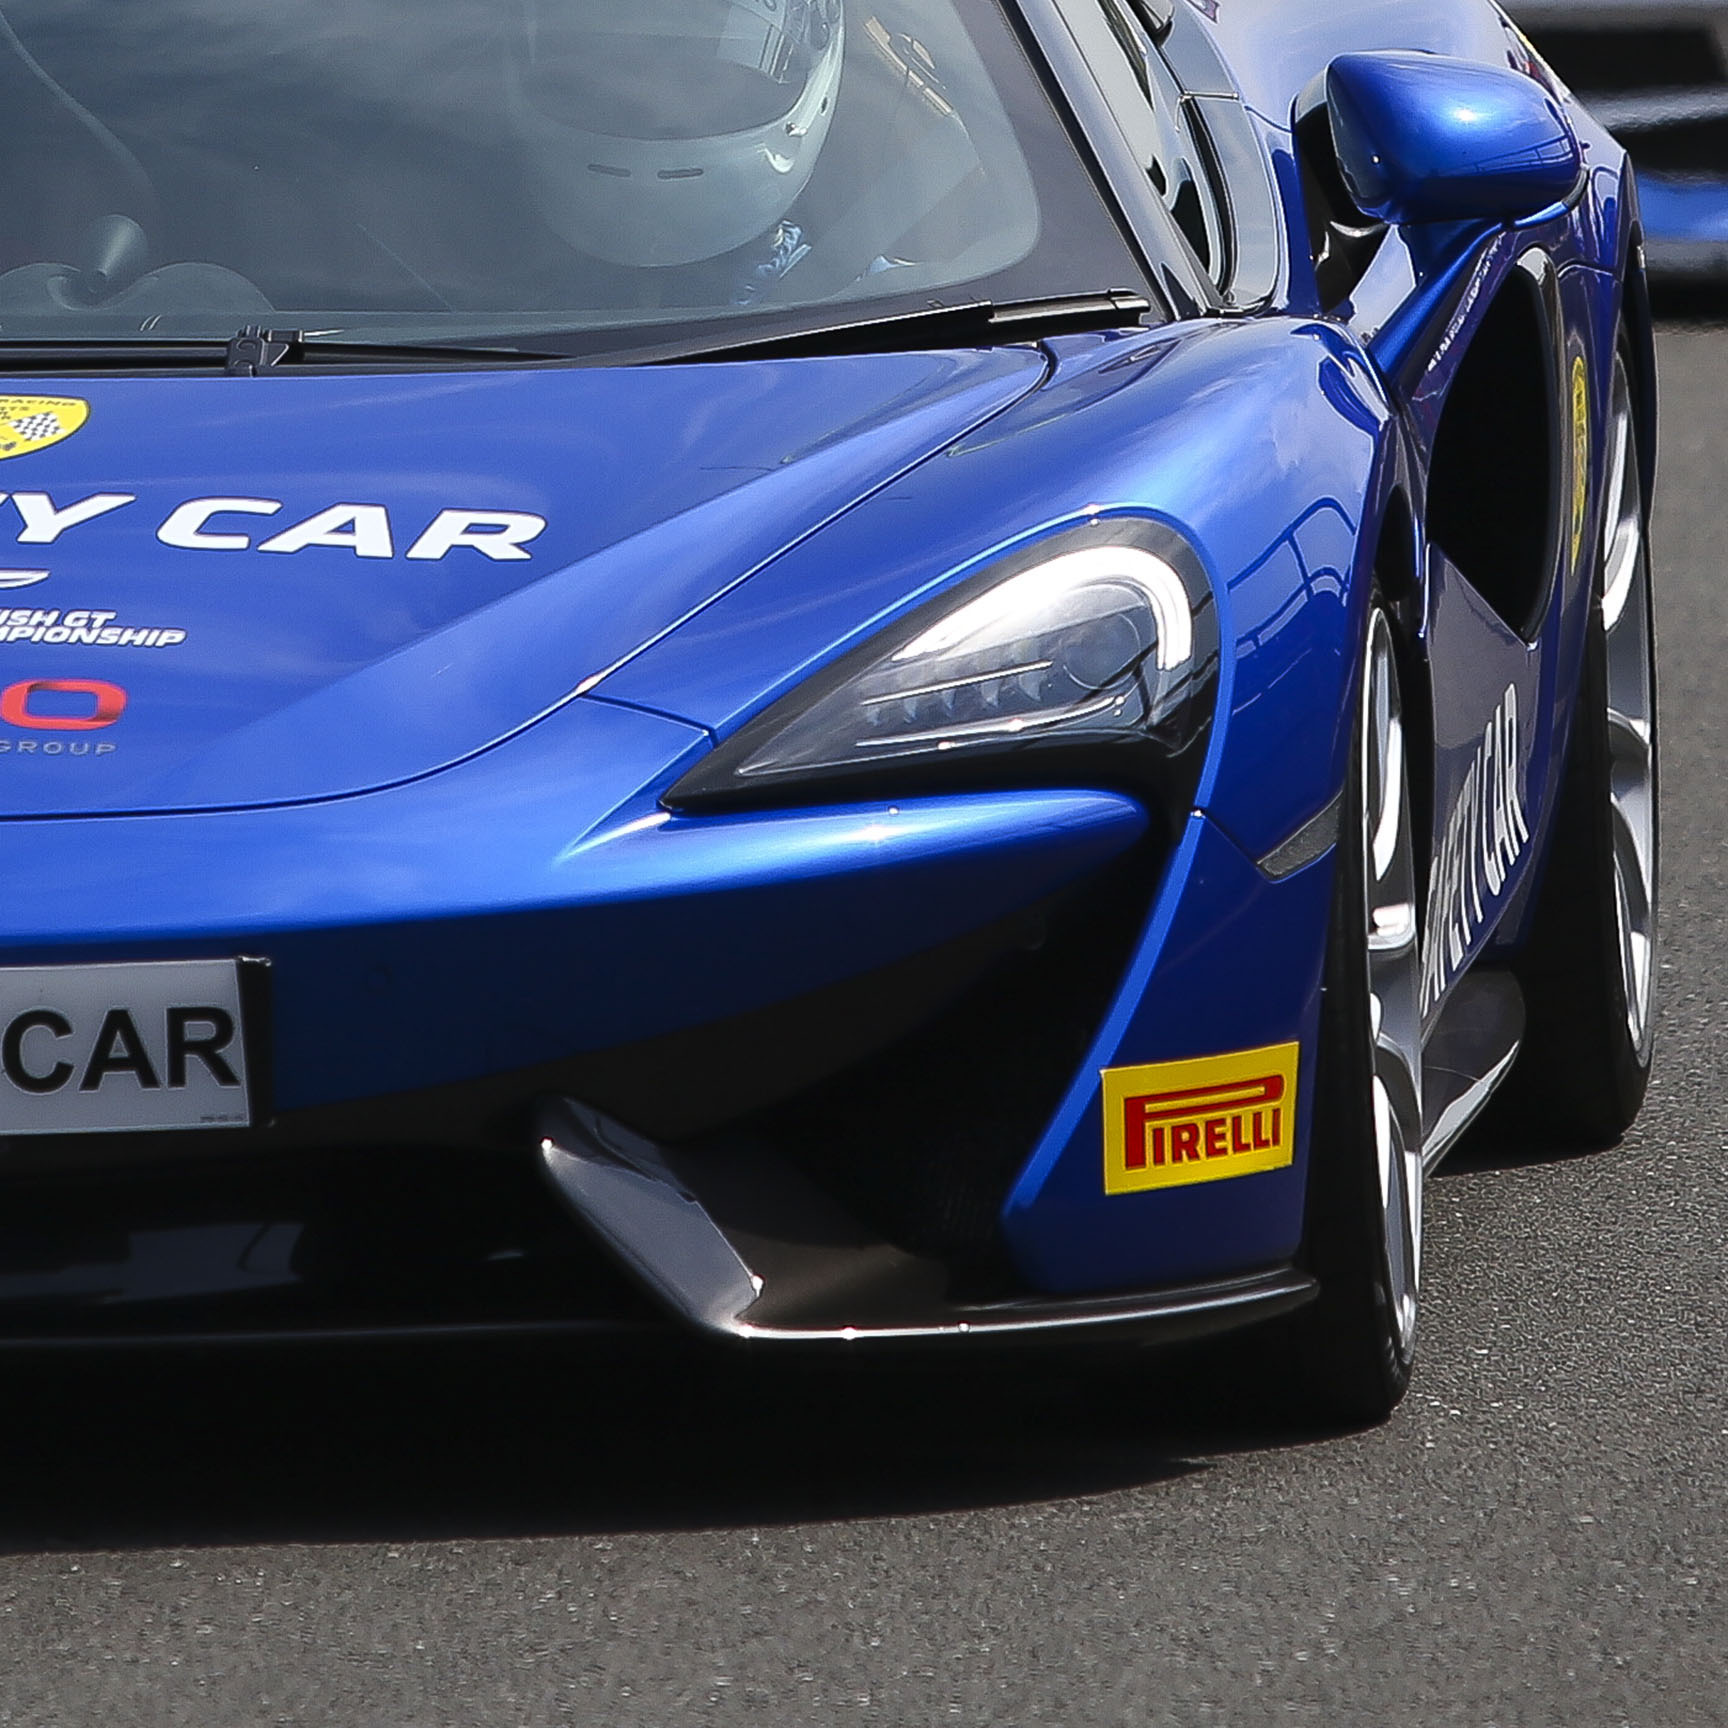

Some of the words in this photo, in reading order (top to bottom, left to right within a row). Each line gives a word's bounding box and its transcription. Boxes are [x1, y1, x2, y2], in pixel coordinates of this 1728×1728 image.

[156, 497, 548, 561] CAR
[59, 610, 116, 627] GT
[1419, 746, 1484, 1020] AFETY
[0, 1005, 242, 1095] CAR
[1123, 1073, 1285, 1171] PIRELLI
